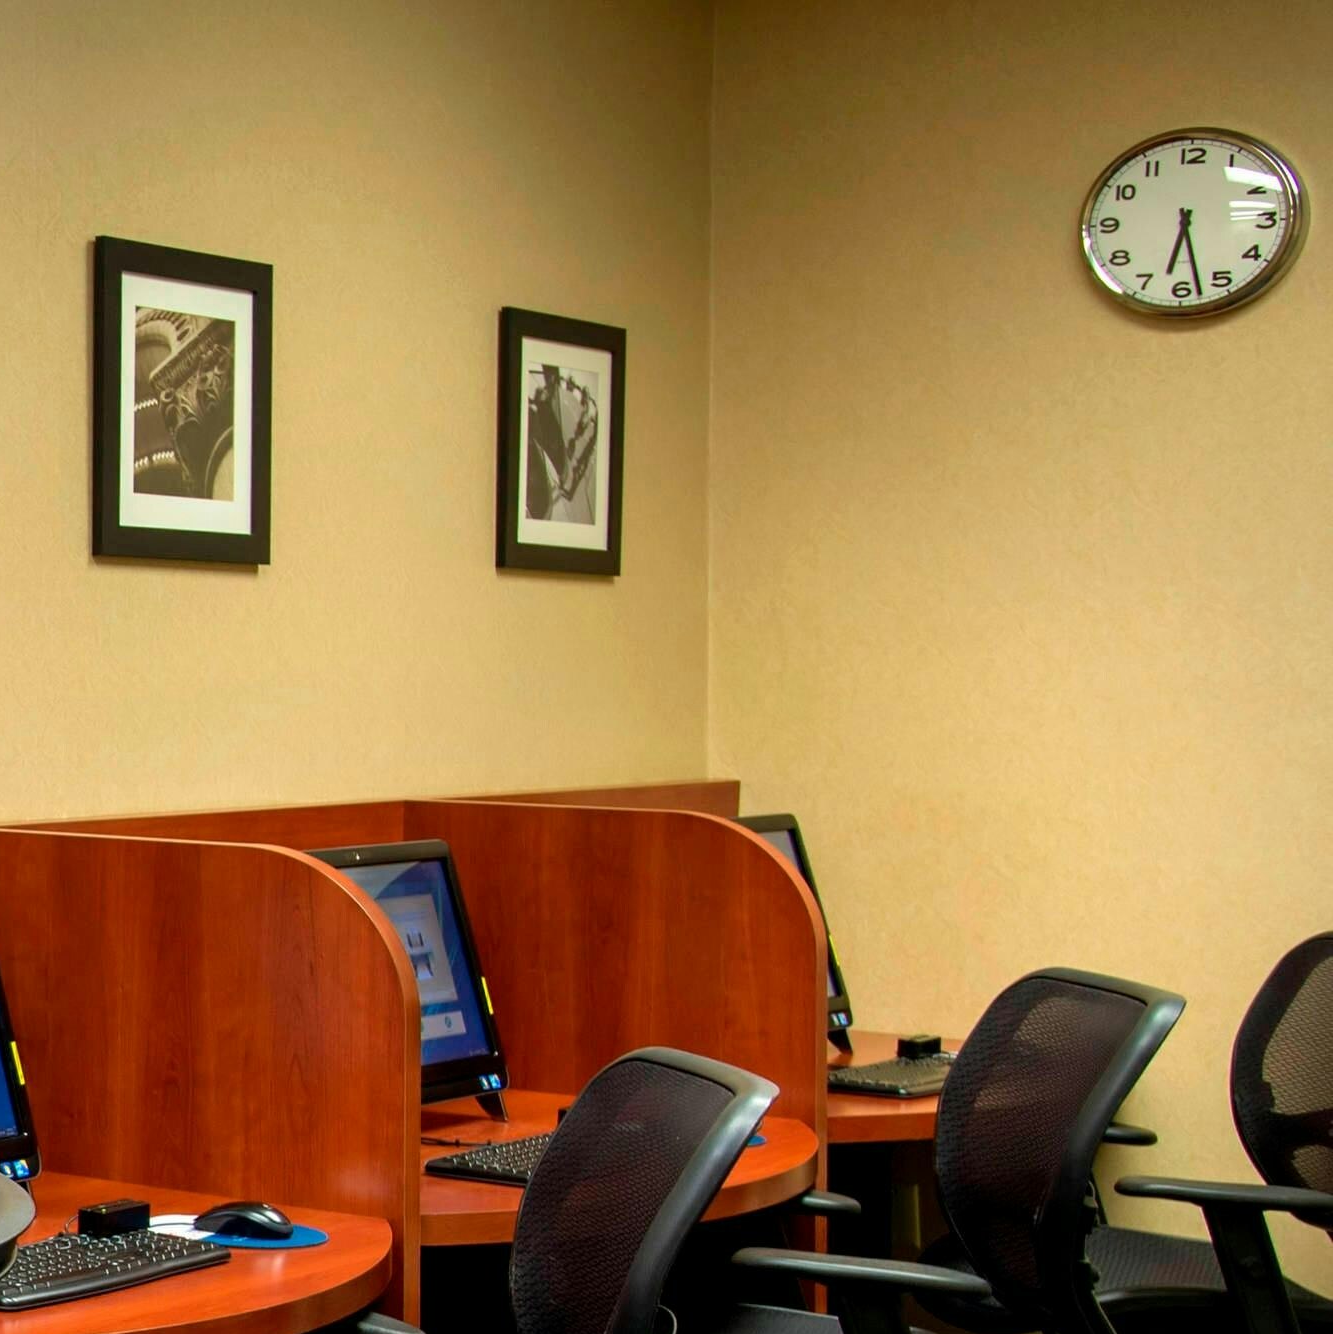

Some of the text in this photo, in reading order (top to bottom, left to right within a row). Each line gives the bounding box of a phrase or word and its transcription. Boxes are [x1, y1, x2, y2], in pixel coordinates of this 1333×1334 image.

[1181, 147, 1207, 165] 12
[1144, 160, 1160, 177] 11
[1116, 184, 1136, 201] 10
[1100, 217, 1120, 234] 9
[1255, 211, 1278, 229] 3
[1109, 250, 1131, 266] 8
[1242, 244, 1262, 261] 4
[1136, 273, 1154, 291] 7
[1211, 271, 1232, 288] 5
[1171, 281, 1192, 298] 6
